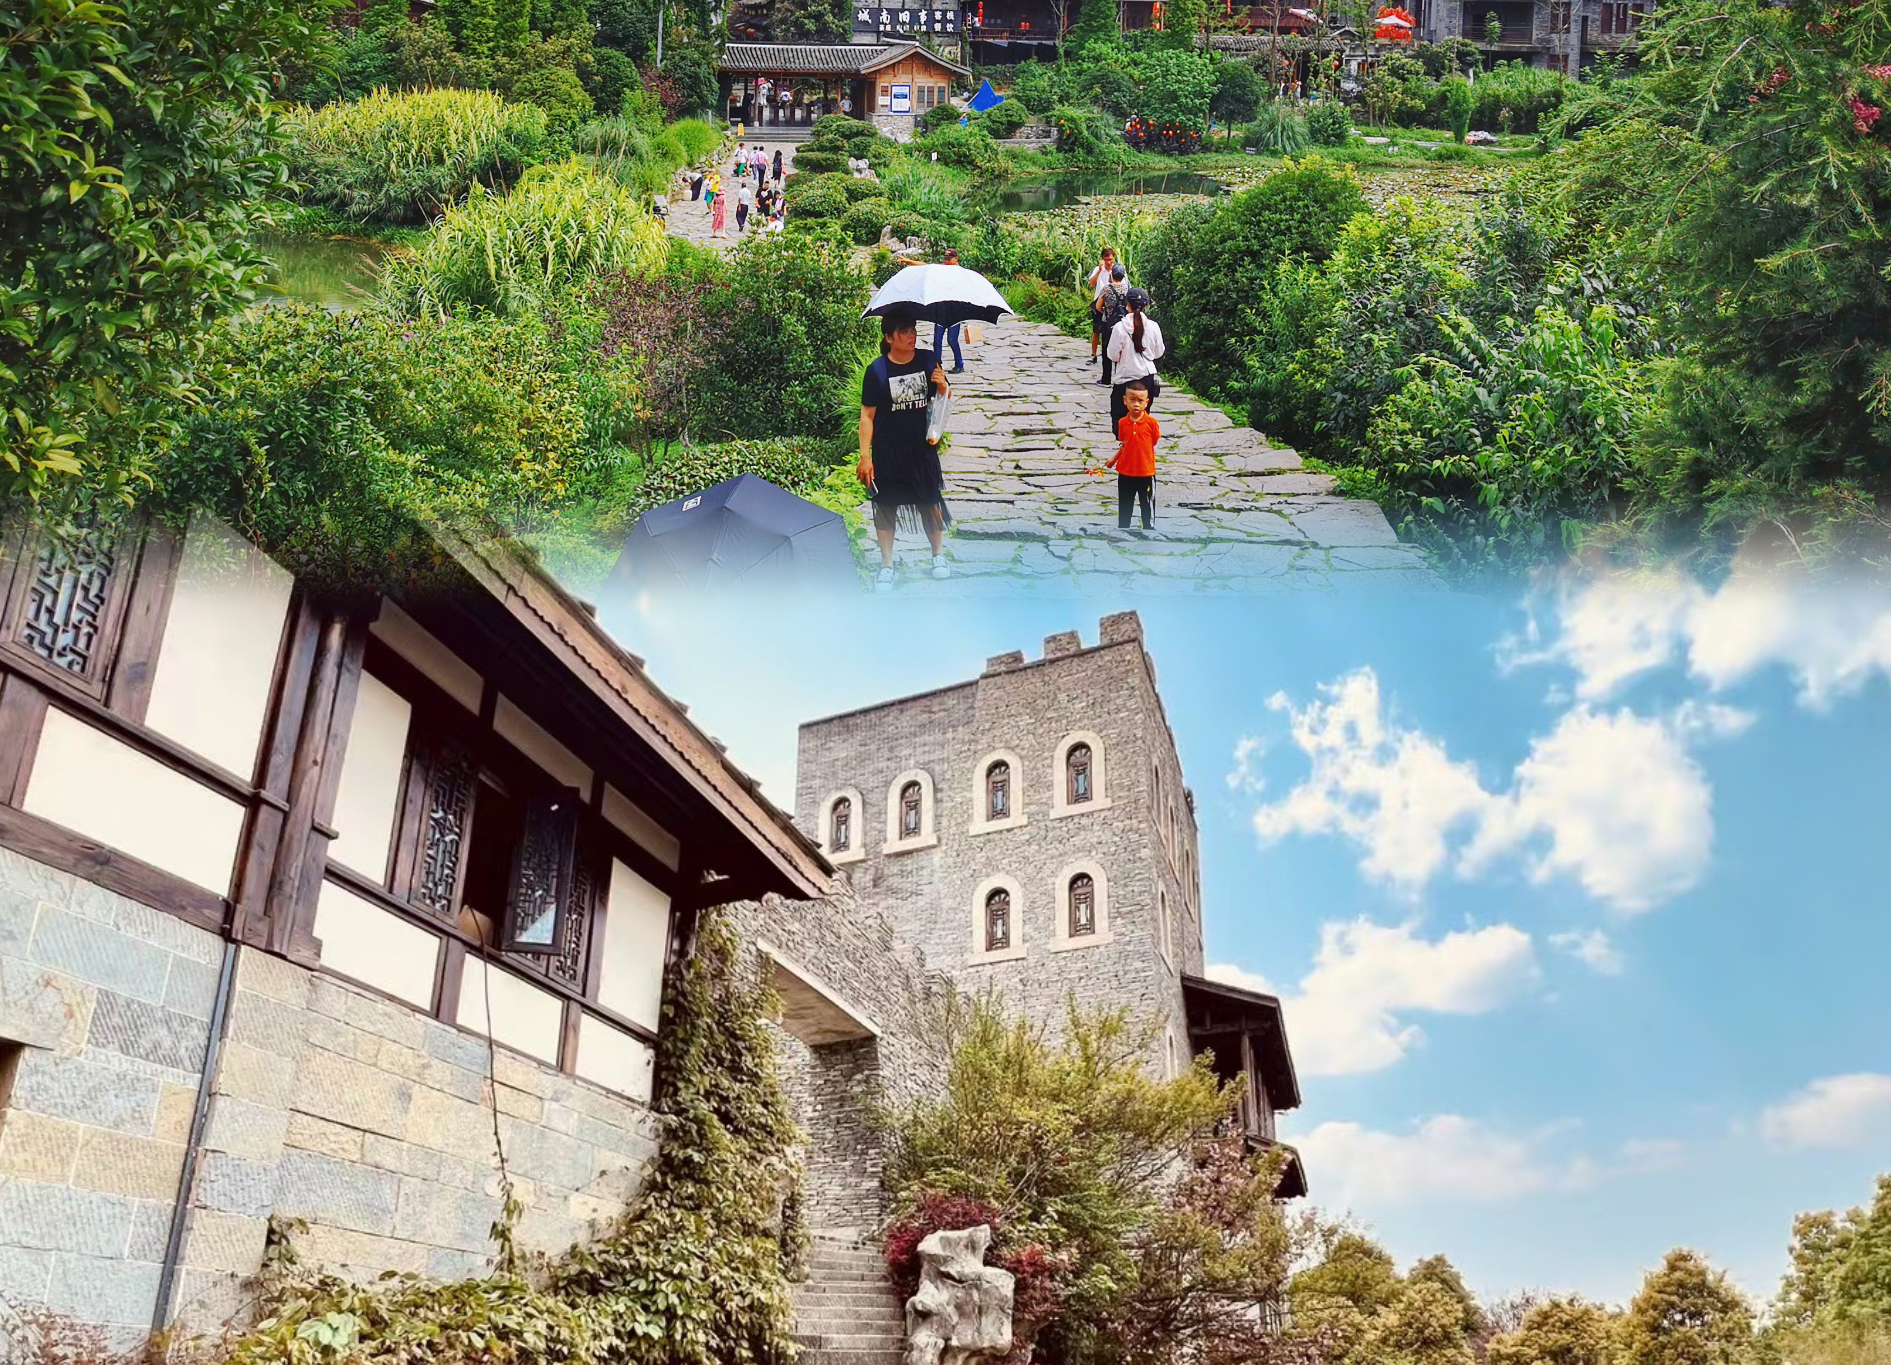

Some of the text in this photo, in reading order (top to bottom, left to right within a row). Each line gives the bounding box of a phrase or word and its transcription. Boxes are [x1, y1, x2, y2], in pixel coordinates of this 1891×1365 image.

[857, 8, 928, 24] 城南旧事
[892, 402, 913, 411] DON'T
